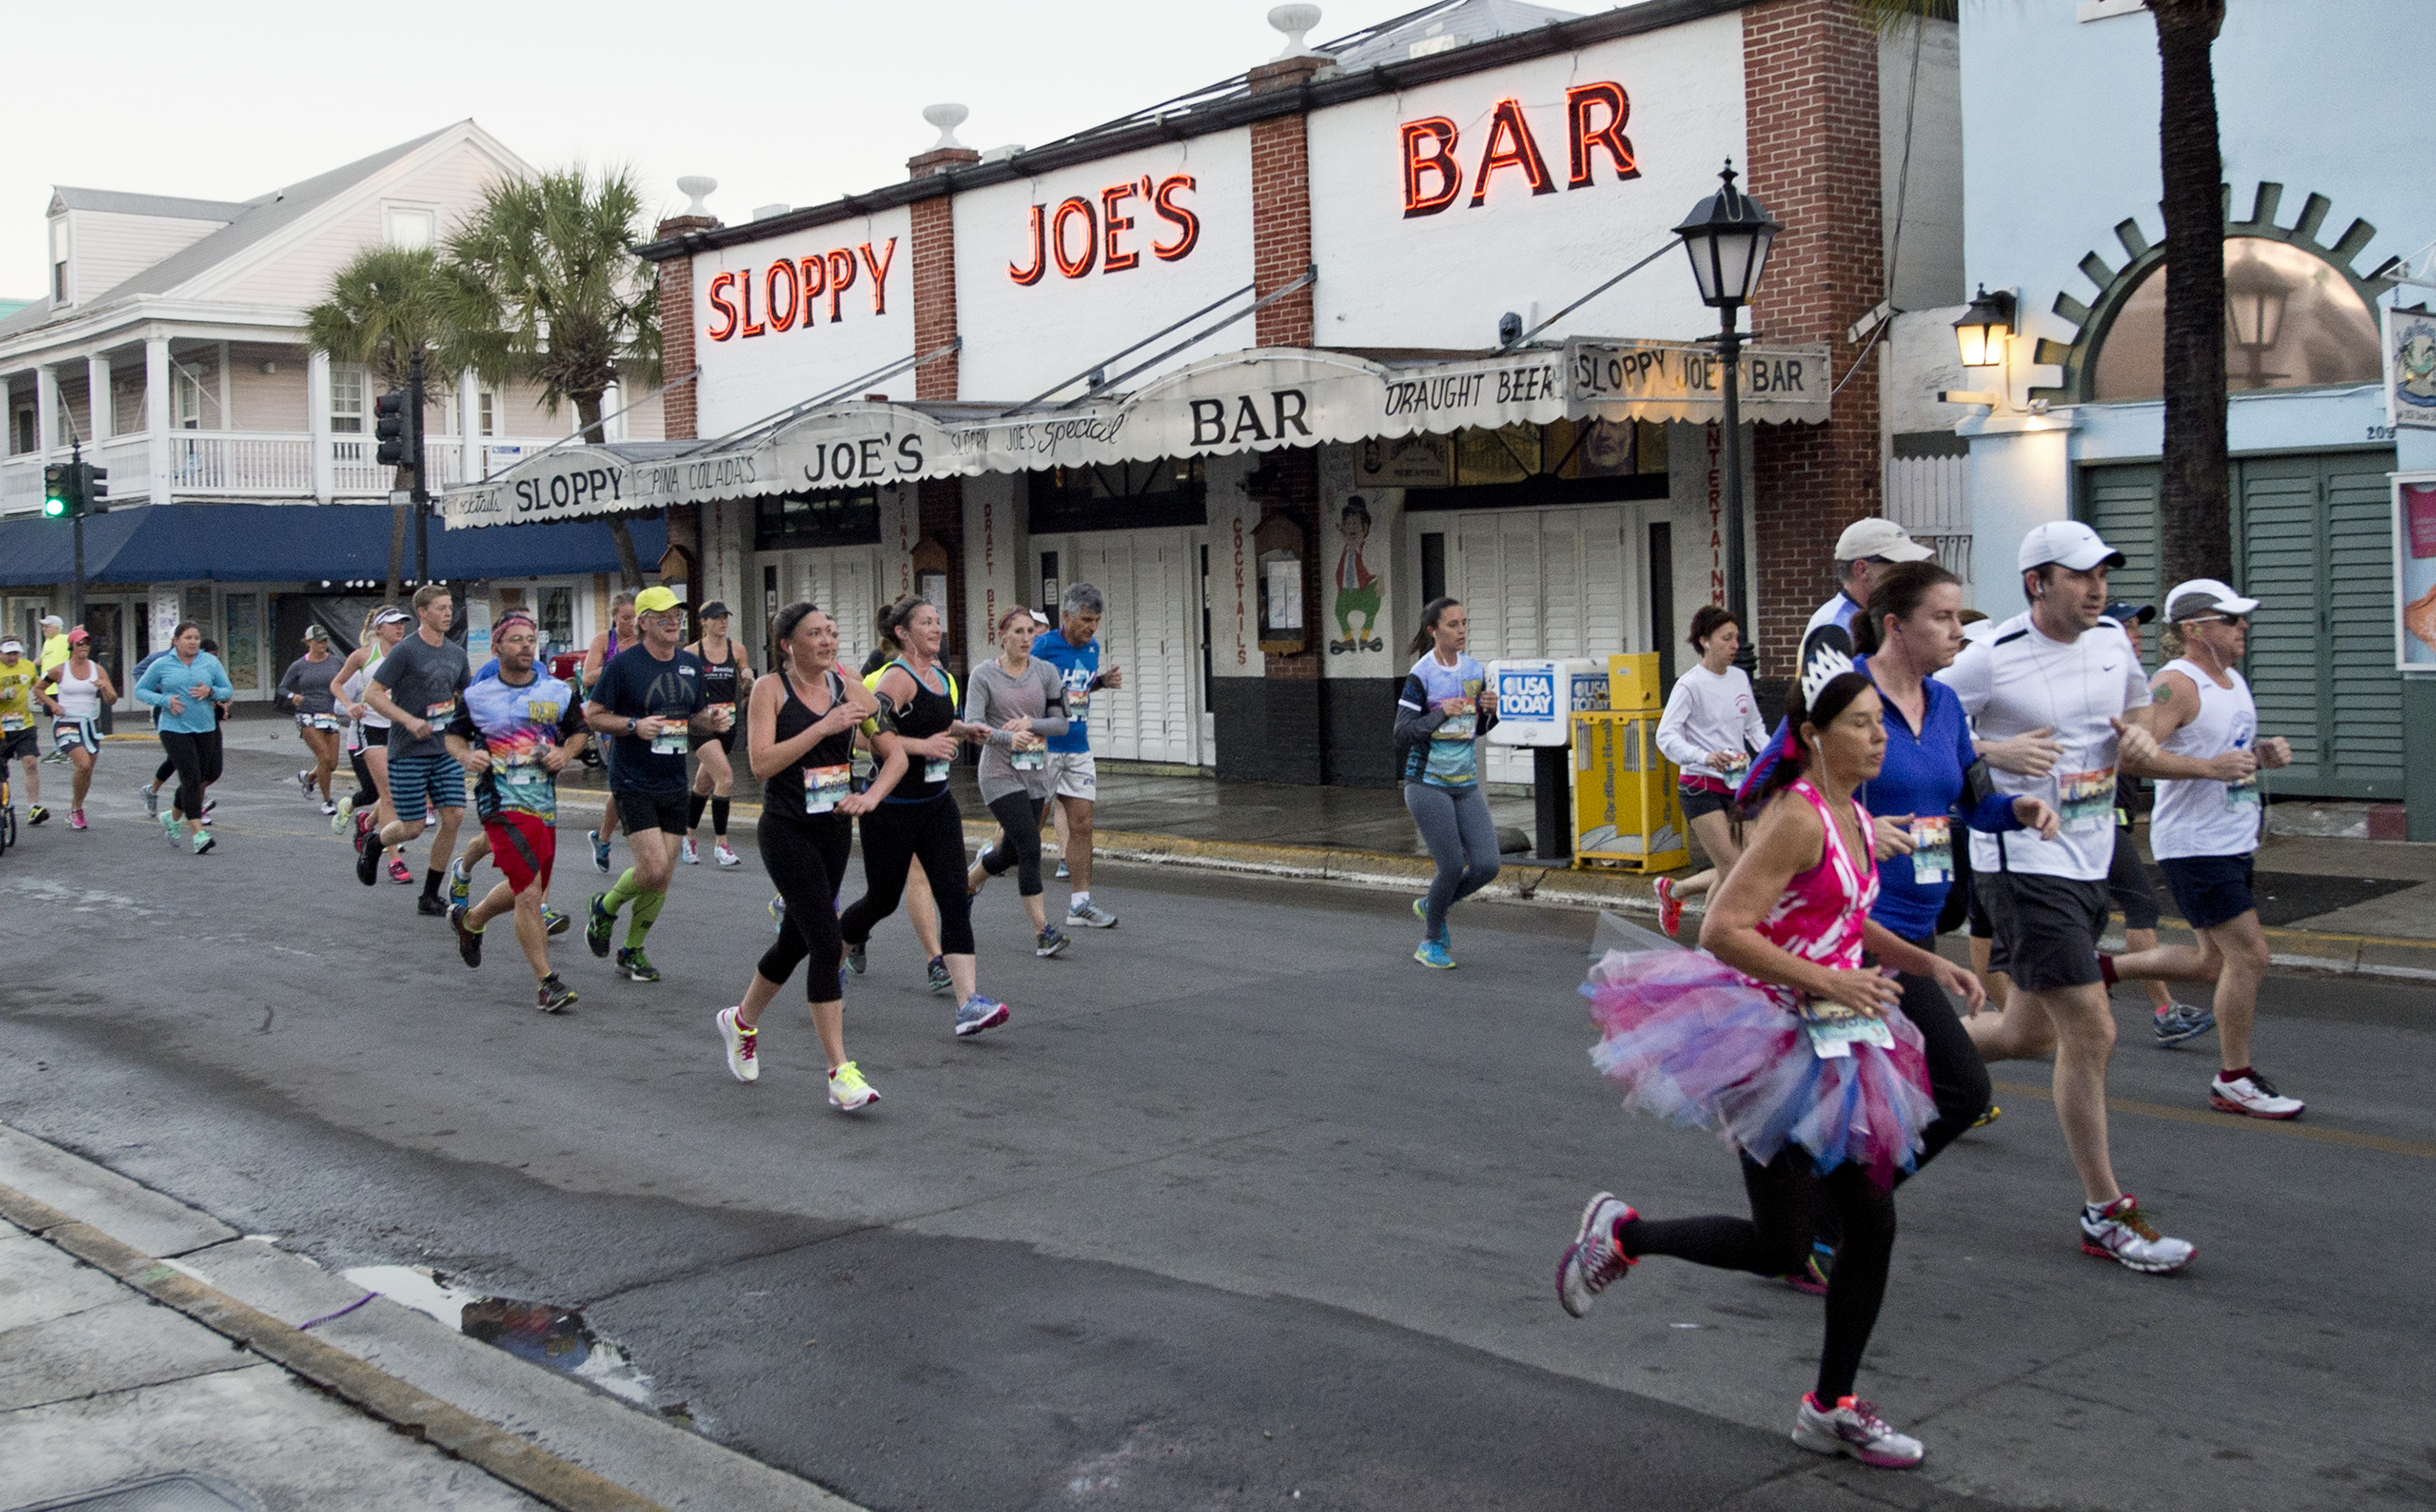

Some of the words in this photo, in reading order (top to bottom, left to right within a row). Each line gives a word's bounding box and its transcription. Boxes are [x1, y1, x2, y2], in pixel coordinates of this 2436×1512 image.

[704, 236, 898, 342] SLOPPY
[1005, 174, 1200, 286] JOE'S
[1397, 81, 1642, 219] BAR
[1384, 374, 1485, 416] DRAUGHT
[1497, 365, 1553, 404] BEER
[1579, 349, 1665, 392] SLOPPY
[1676, 356, 1738, 391] JOE
[1752, 360, 1803, 392] BAR
[951, 428, 989, 456] SLOPPY
[1006, 423, 1036, 451] JOE'S
[1038, 408, 1125, 457] Special
[1189, 389, 1313, 446] BAR
[651, 466, 680, 495] PINA
[689, 456, 756, 490] COLADA'S
[804, 432, 924, 482] JOE'S
[516, 466, 624, 512] SLOPPY
[983, 503, 994, 577] DRAFT
[1233, 516, 1247, 666] COCKTAILS
[986, 588, 996, 646] BEER
[1061, 668, 1096, 690] HEY
[1516, 676, 1552, 696] USA
[1584, 680, 1609, 694] USA
[1500, 694, 1553, 714] TODAY
